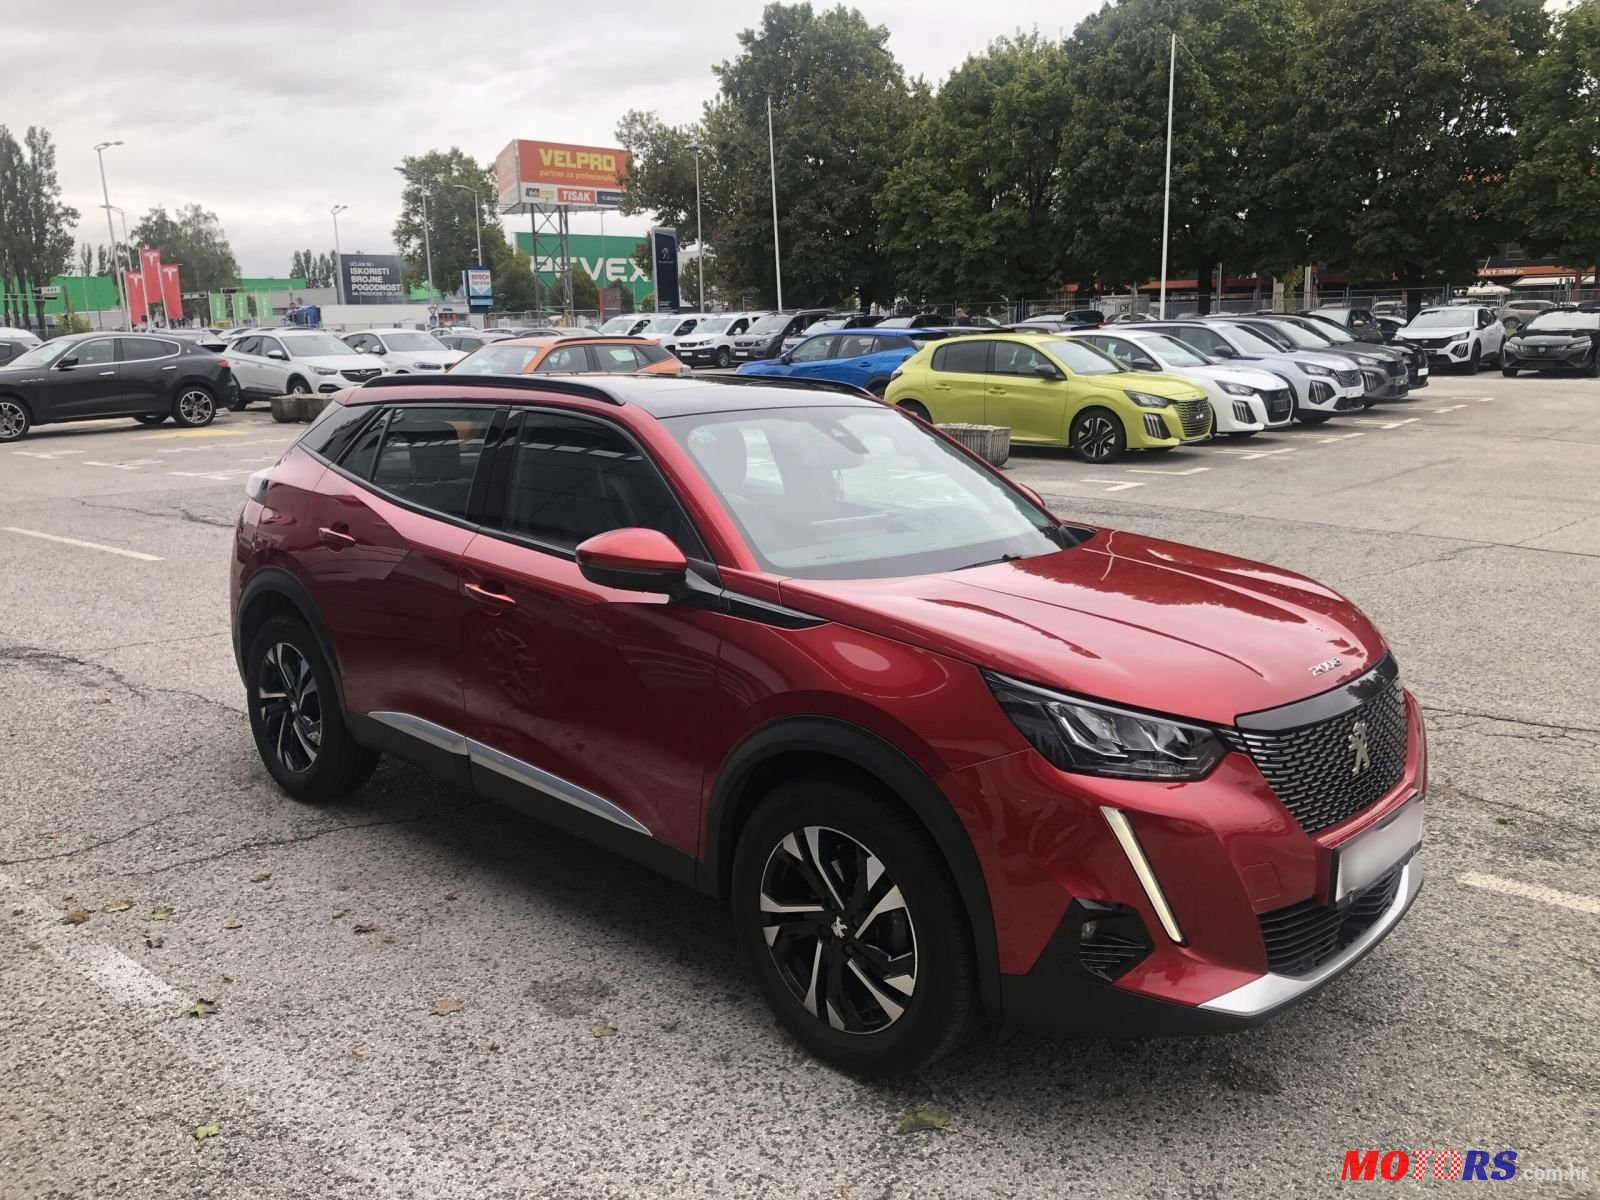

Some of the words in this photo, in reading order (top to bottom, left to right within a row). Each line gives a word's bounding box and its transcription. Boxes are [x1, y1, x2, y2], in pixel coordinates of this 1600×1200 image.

[539, 148, 616, 172] VELPRO
[540, 169, 564, 178] partner
[561, 190, 591, 202] TISAK
[350, 267, 390, 276] ISKORISTI
[351, 275, 384, 283] BROJNE
[1308, 656, 1343, 677] 2008
